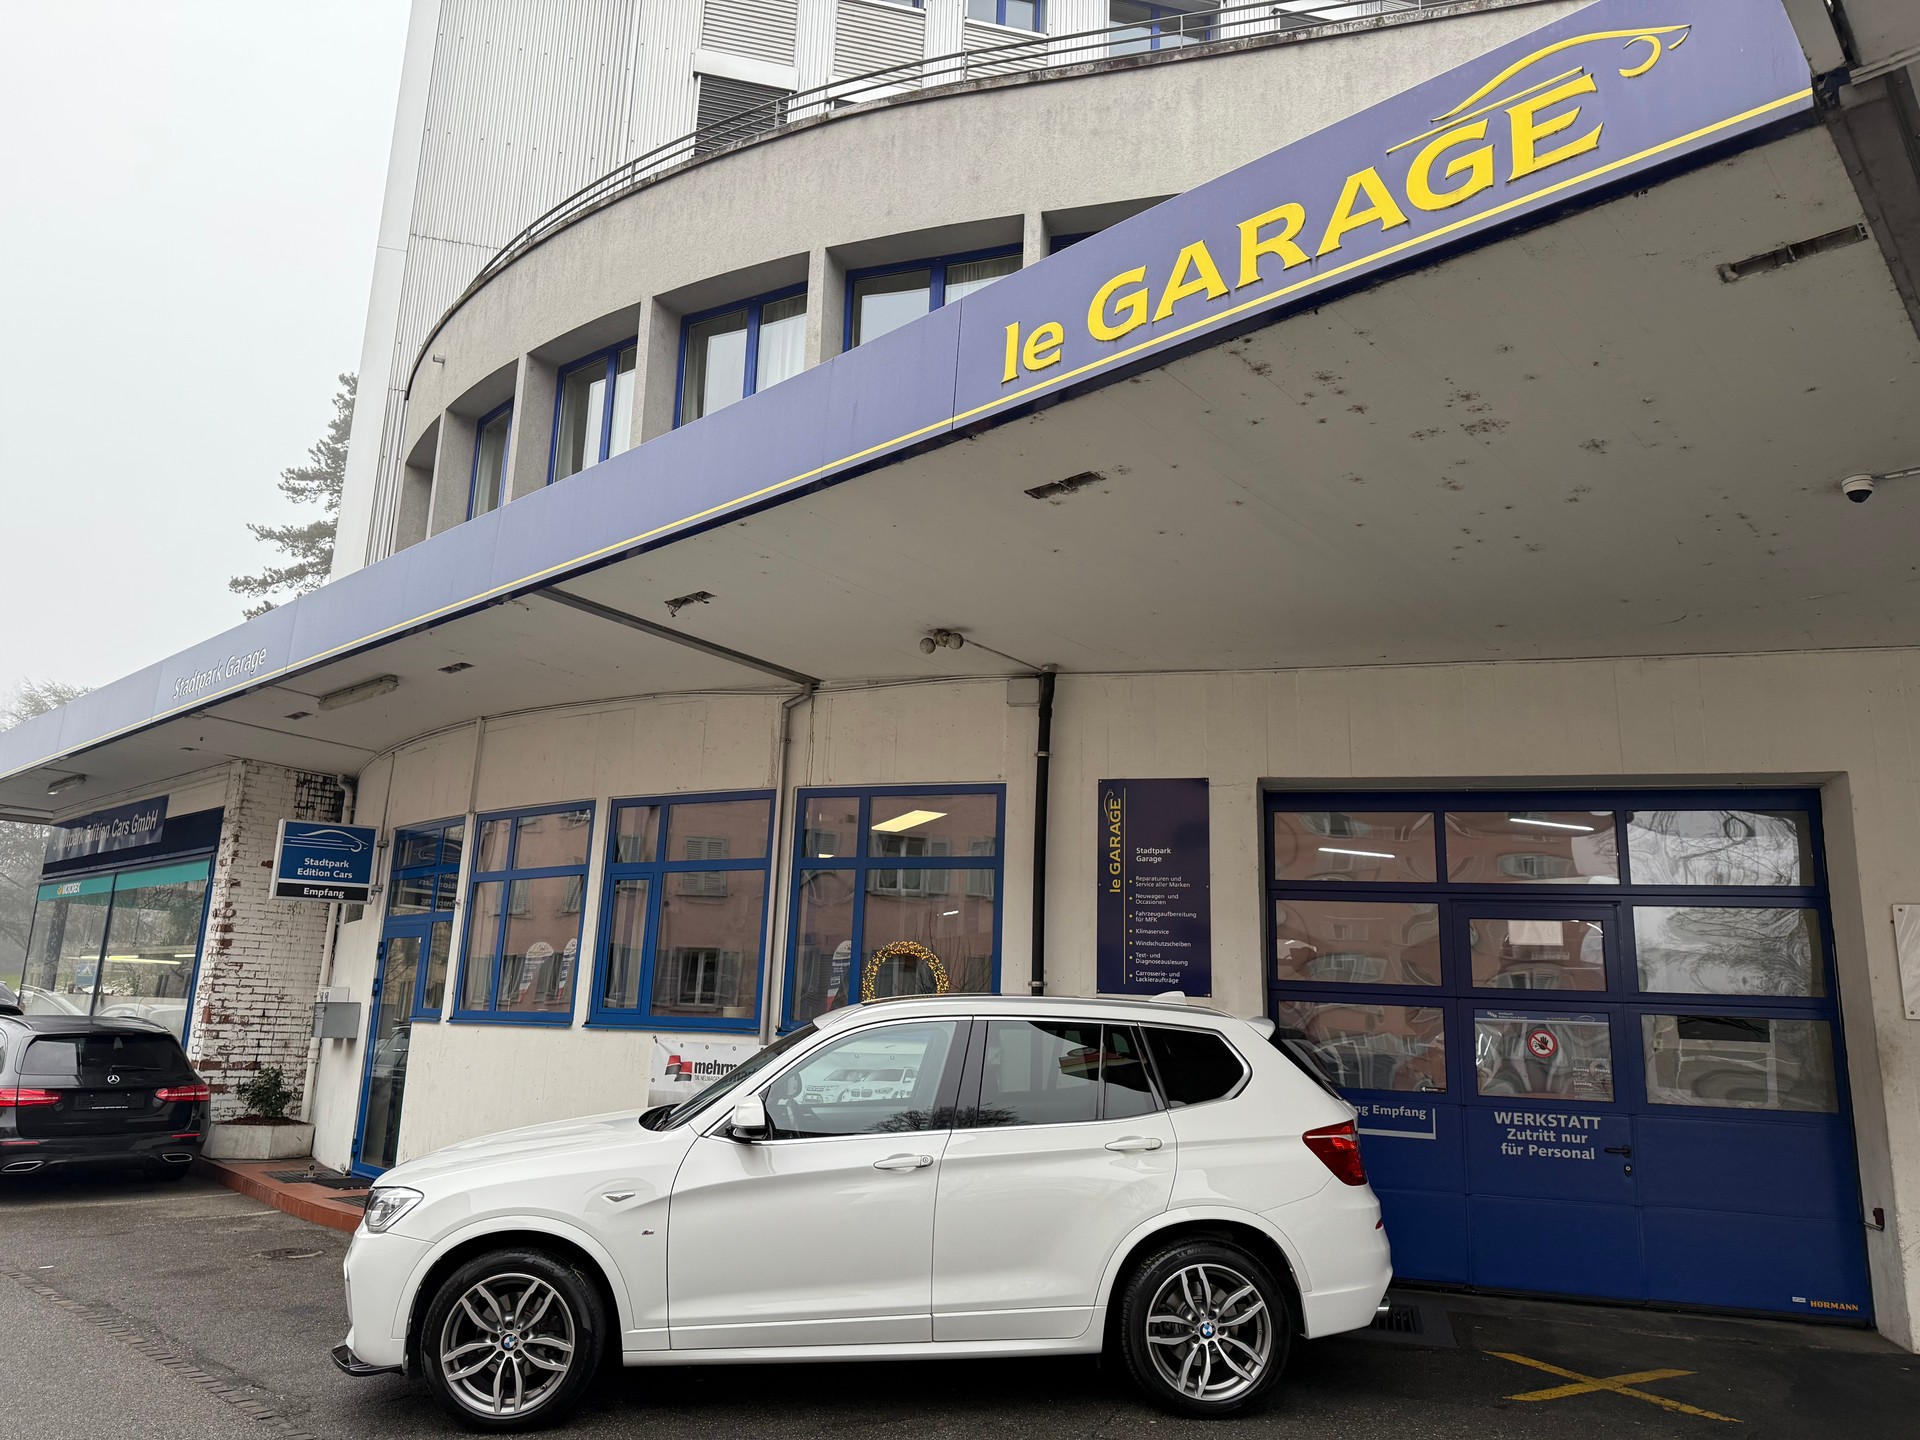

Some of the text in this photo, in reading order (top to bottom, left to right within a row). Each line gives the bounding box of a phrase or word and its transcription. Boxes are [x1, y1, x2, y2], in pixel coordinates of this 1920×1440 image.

[1001, 74, 1604, 384] le GARAGE
[173, 647, 267, 699] Stadtpark Garage
[111, 818, 130, 838] Cars
[131, 809, 159, 834] GmbH
[1109, 798, 1121, 893] le GARAGE
[1136, 847, 1172, 855] Stadtpark
[304, 857, 350, 869] Stadtpark
[1136, 855, 1163, 863] Garage
[297, 867, 353, 879] Edition Cars
[303, 887, 345, 899] Empfang
[1135, 910, 1197, 919] Fahrzeugaufbereitung
[1135, 940, 1192, 948] Windschutzscheiben
[694, 1059, 738, 1074] mehrm
[1372, 1104, 1427, 1120] Empfang
[1494, 1111, 1602, 1130] WERKSTATT
[1507, 1128, 1588, 1144] Zutritt nur
[1501, 1142, 1595, 1160] für Personal
